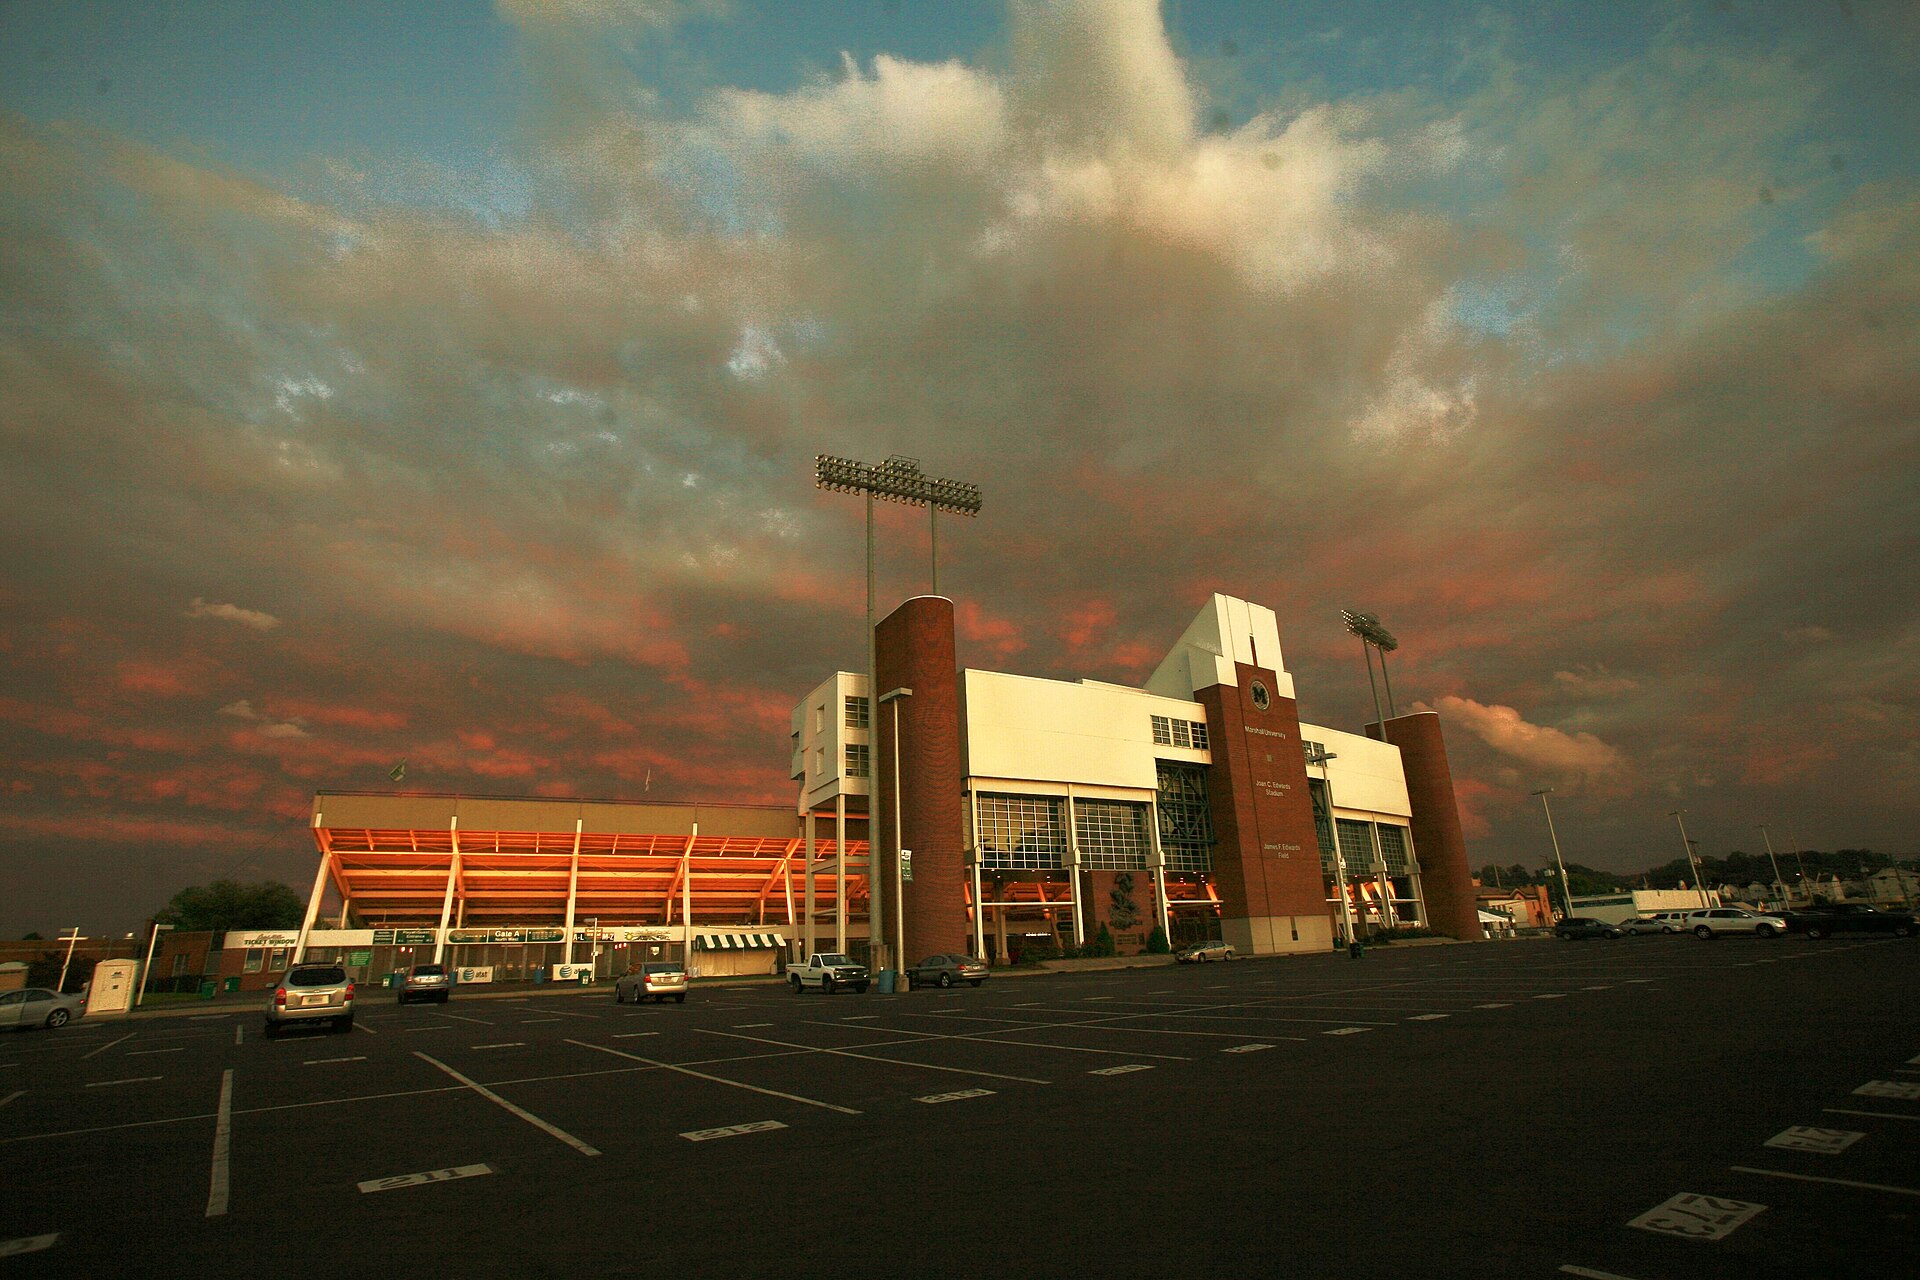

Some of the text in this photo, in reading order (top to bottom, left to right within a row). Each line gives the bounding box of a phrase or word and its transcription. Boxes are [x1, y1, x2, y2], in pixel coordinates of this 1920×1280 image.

[1244, 725, 1286, 740] Marshall University
[1267, 780, 1272, 788] C.
[1272, 781, 1291, 790] Edwards
[1265, 788, 1284, 797] Stadium
[1282, 843, 1301, 851] Edwards
[1278, 851, 1290, 859] Field
[572, 933, 614, 941] A-L M-Z
[695, 1123, 775, 1138] 212
[379, 1168, 462, 1188] 211
